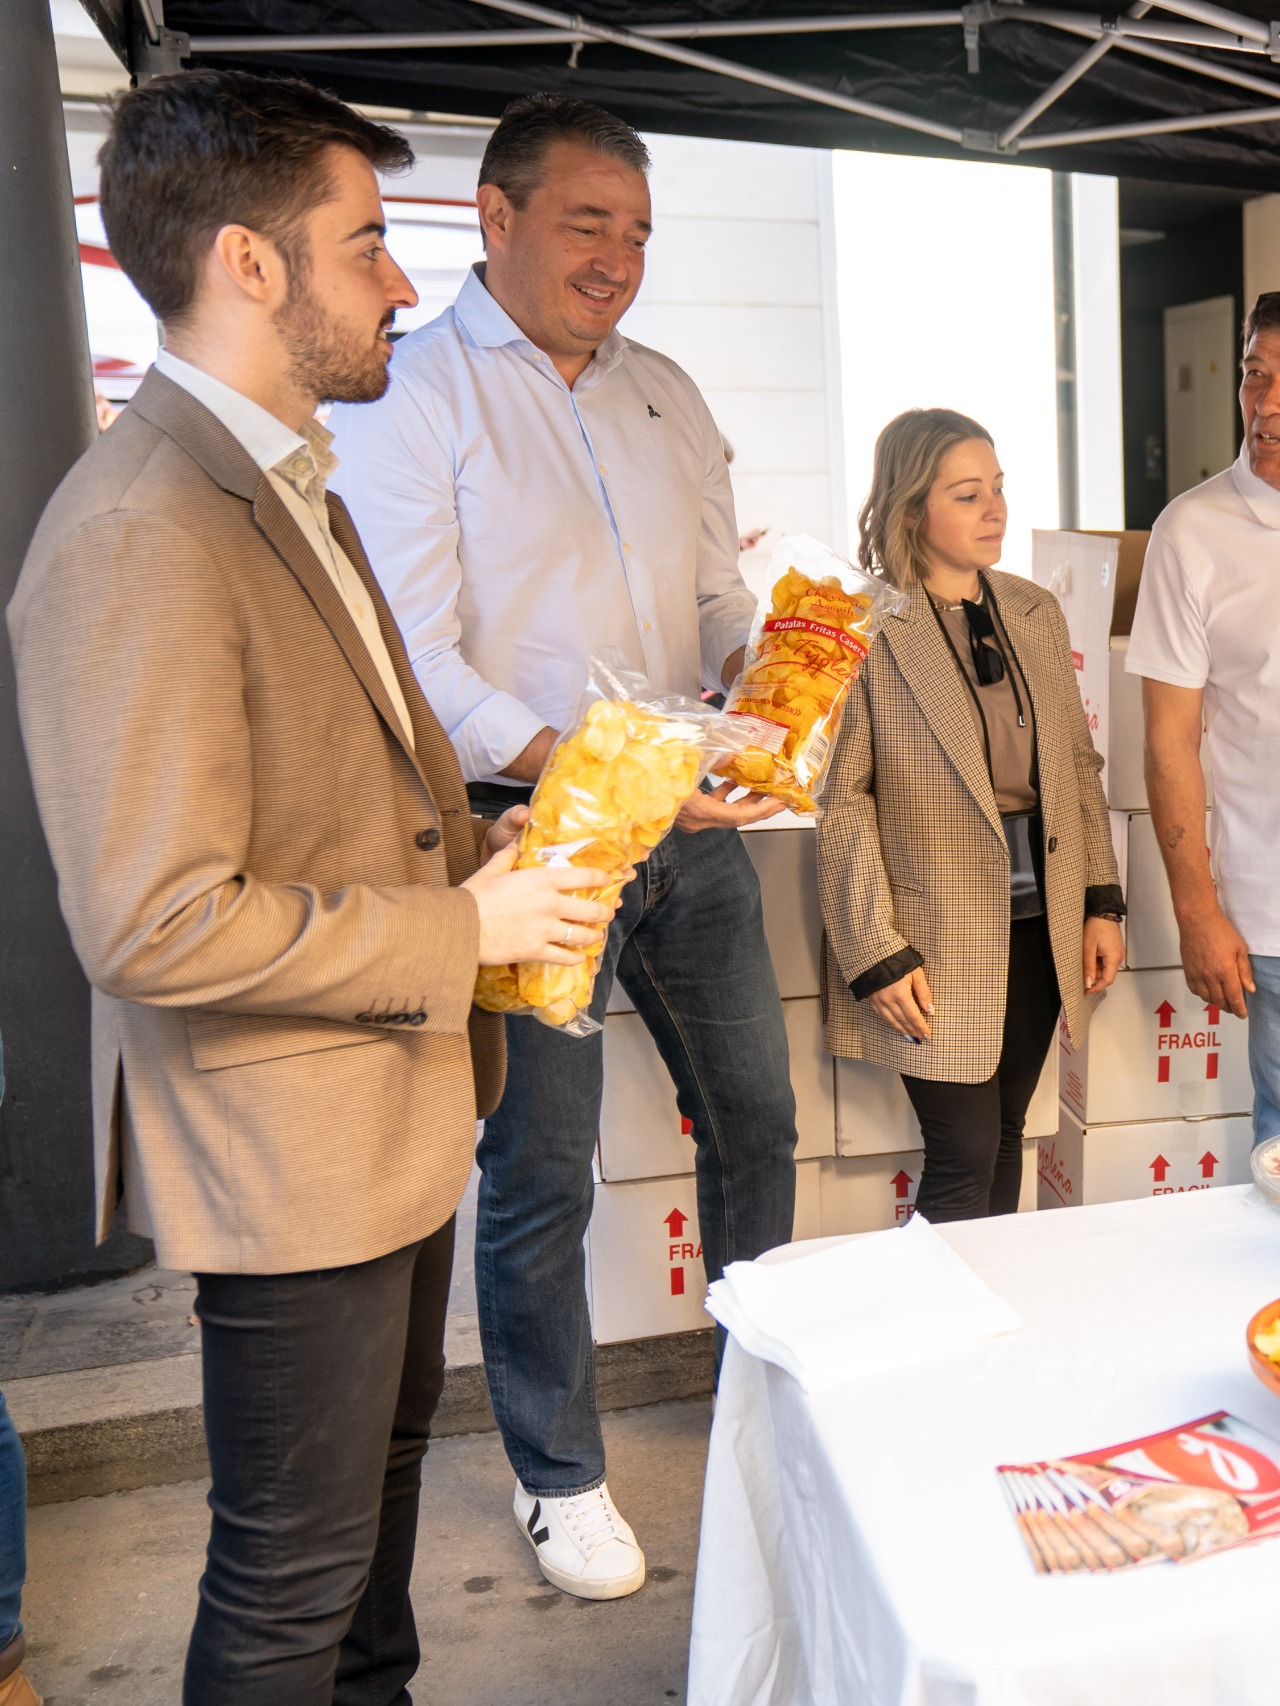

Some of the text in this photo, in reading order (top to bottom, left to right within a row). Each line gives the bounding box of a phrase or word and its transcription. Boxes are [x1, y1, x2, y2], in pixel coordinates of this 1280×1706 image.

[774, 620, 806, 630] Patatas
[809, 623, 837, 638] Fritas
[1158, 1031, 1221, 1050] FRAGIL
